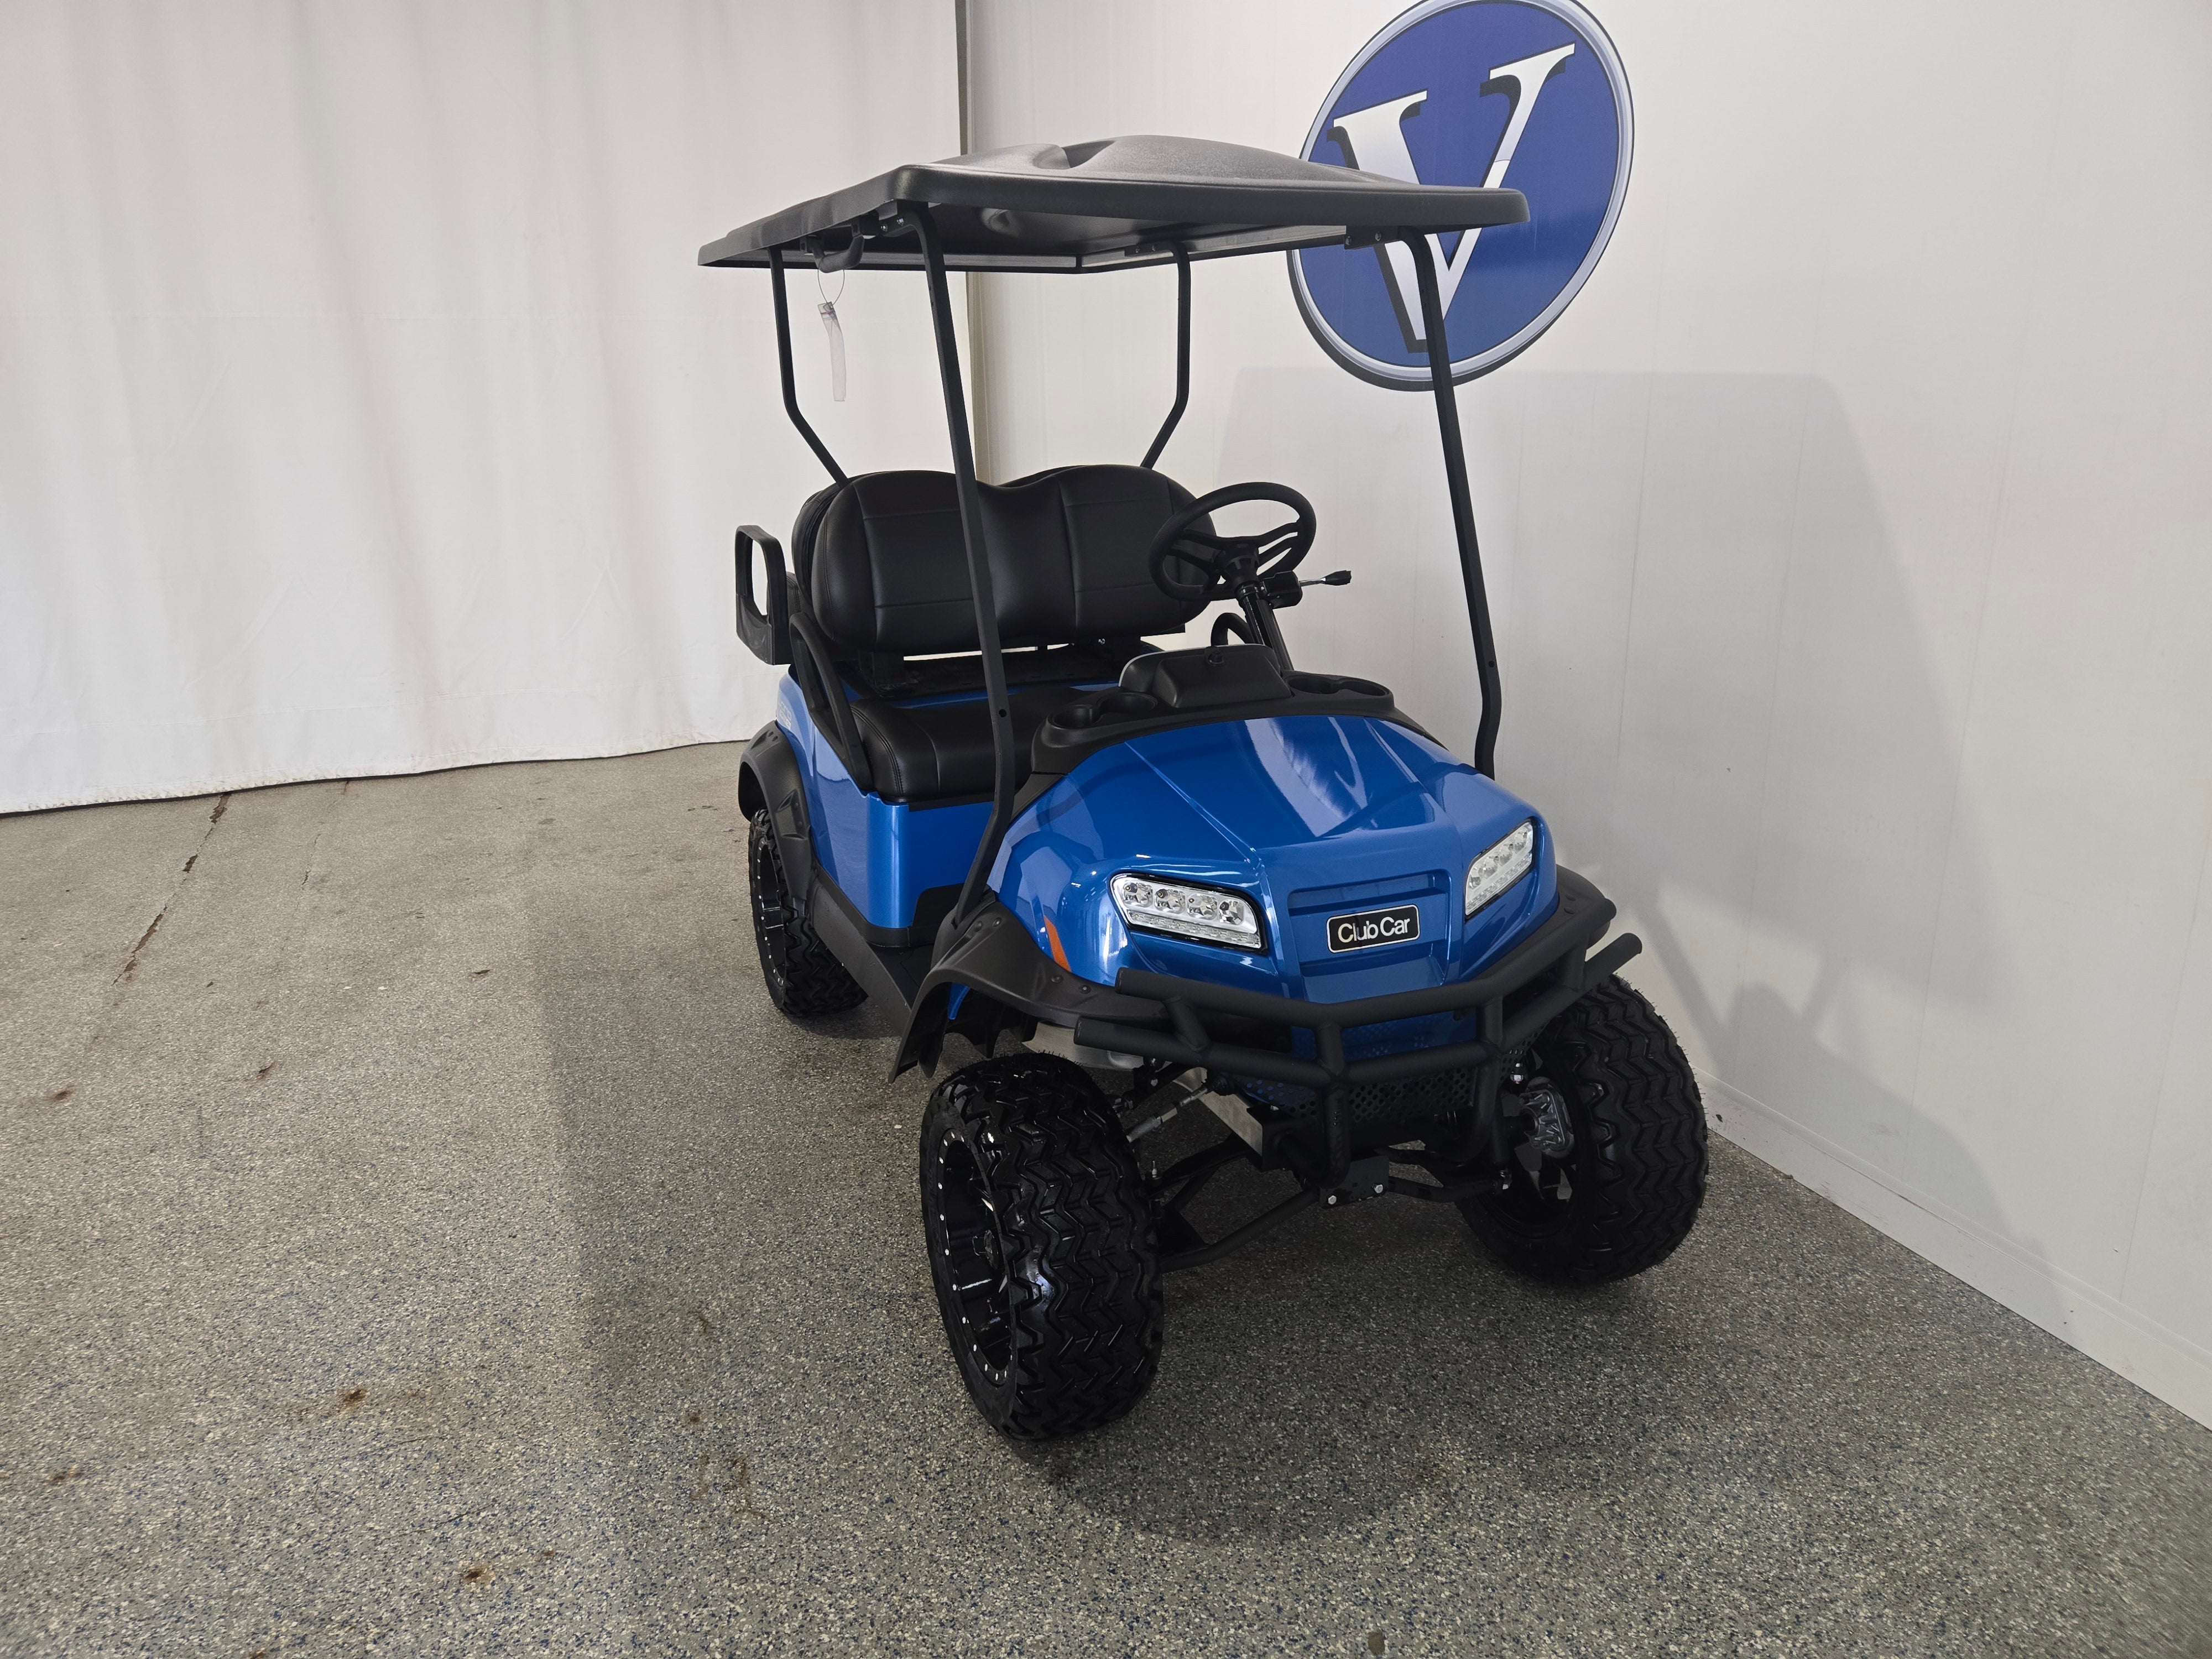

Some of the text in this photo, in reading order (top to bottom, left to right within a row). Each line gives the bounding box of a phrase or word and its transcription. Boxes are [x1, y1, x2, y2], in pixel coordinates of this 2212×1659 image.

[1332, 41, 1575, 341] V
[1338, 916, 1410, 943] Club Car
